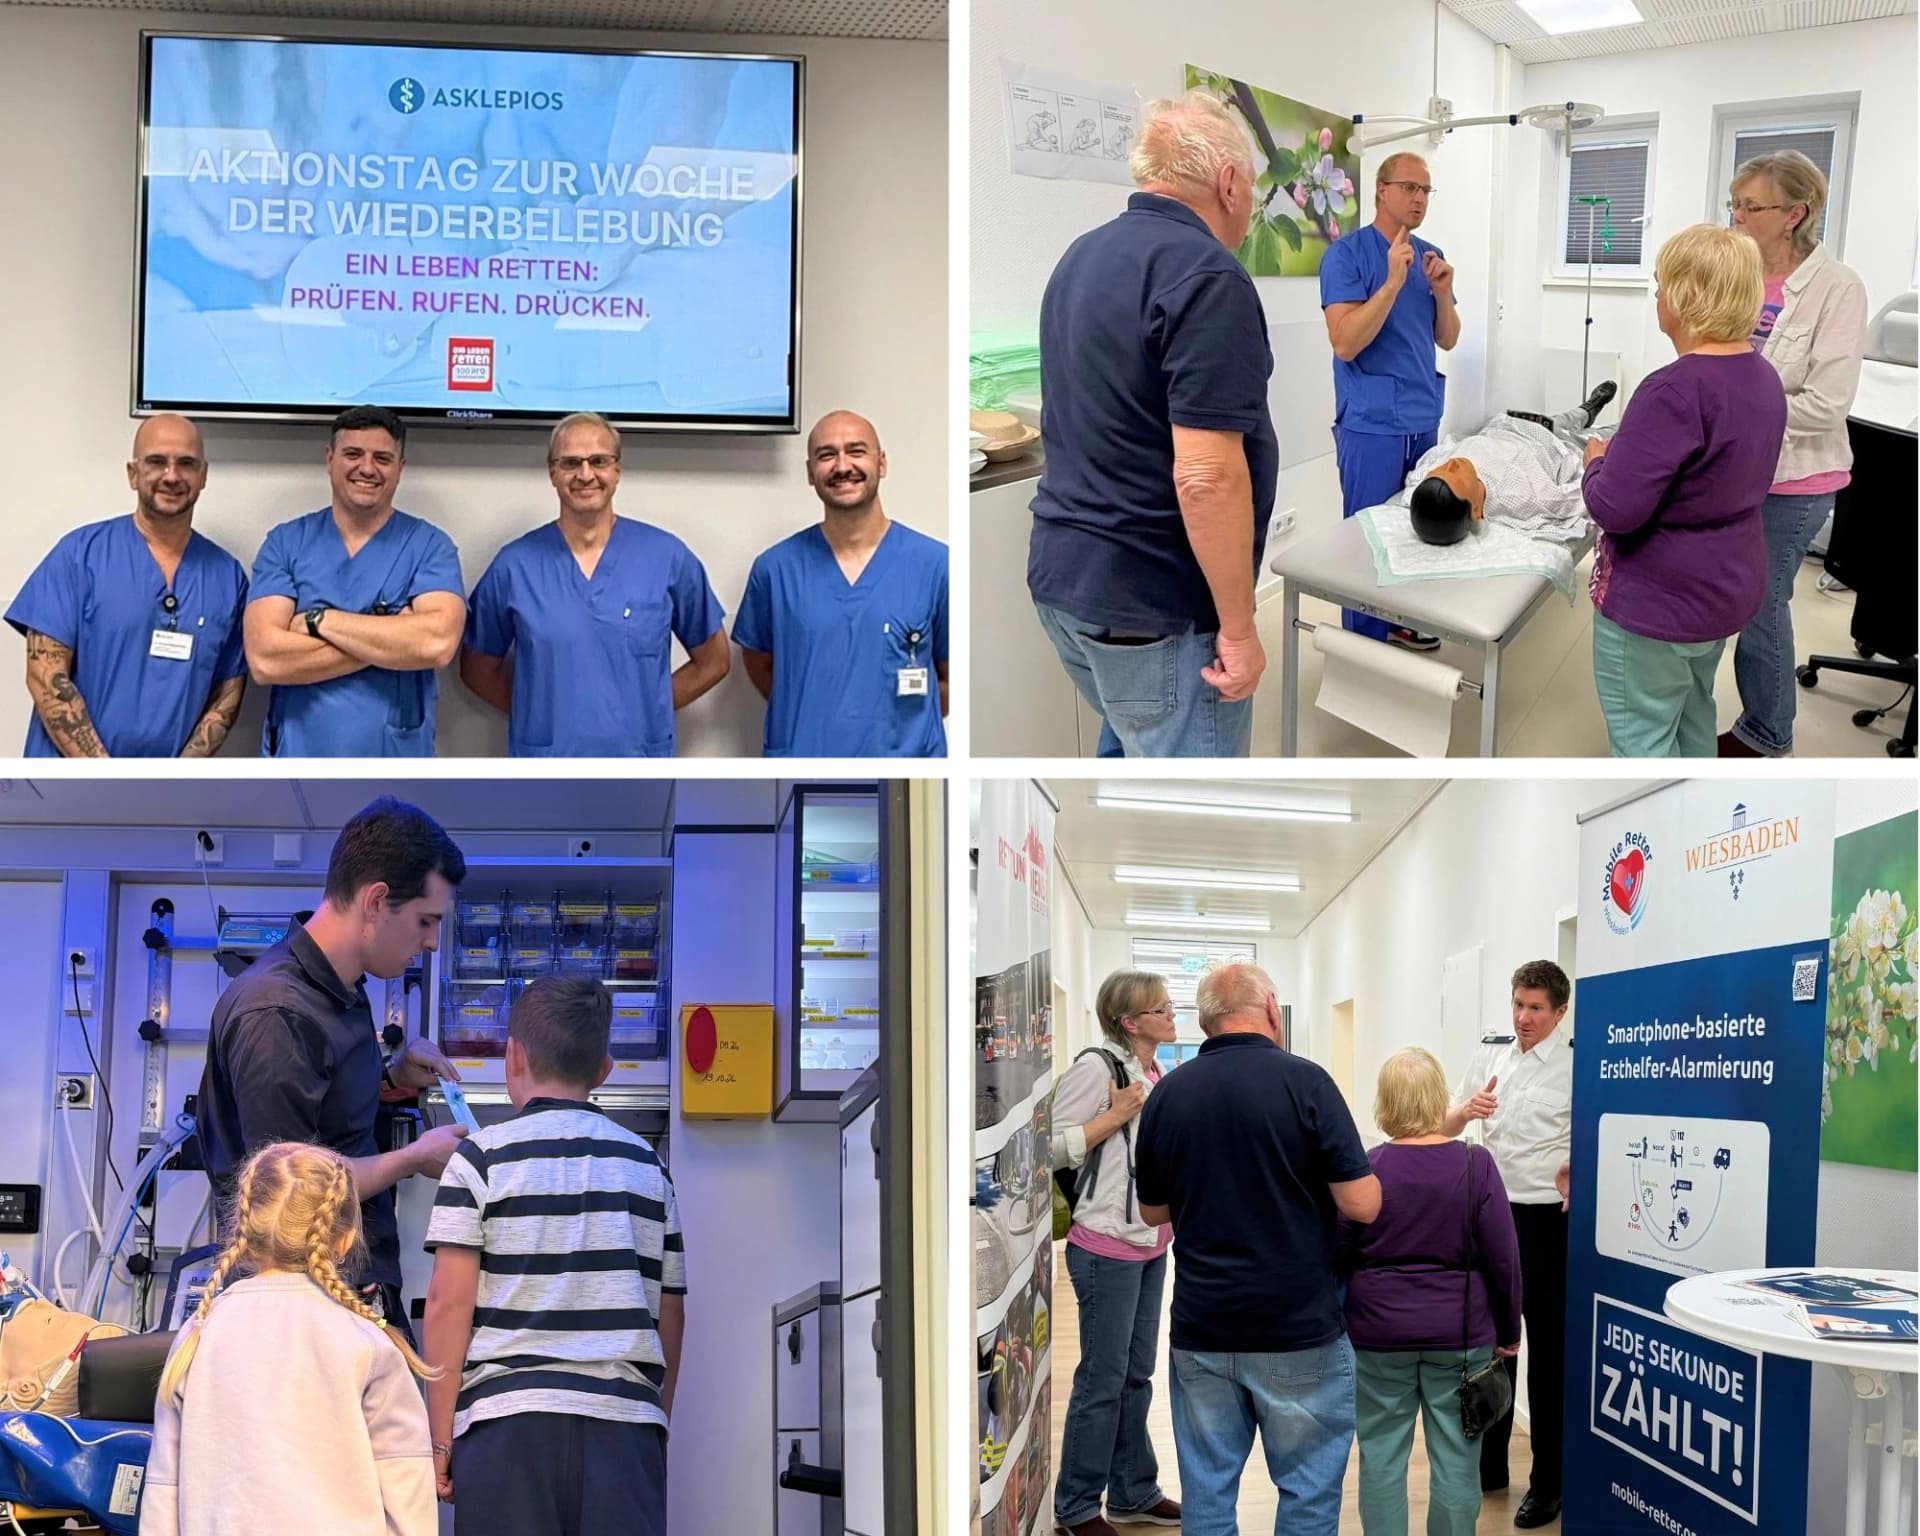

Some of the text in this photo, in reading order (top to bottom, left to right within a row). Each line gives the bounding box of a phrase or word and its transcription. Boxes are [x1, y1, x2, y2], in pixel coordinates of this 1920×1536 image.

[432, 88, 564, 111] ASKLEPIOS
[188, 149, 755, 201] AKTIONSTAG ZUR WOCHE
[228, 197, 724, 248] DER WIEDERBELEBUNG
[345, 253, 599, 282] EIN LEBEN RETTEN:
[290, 282, 651, 319] PRÜFEN. RUFEN. DRÜCKEN.
[1602, 831, 1653, 902] Mobile Retter
[1685, 816, 1801, 873] WIESBADEN
[1607, 1012, 1766, 1047] Smartphone-basierte
[1599, 1053, 1775, 1085] Ersthelfer-Alarmierung
[1603, 1322, 1744, 1403] JEDE SEKUNDE
[1600, 1359, 1744, 1487] ZÄHLT!
